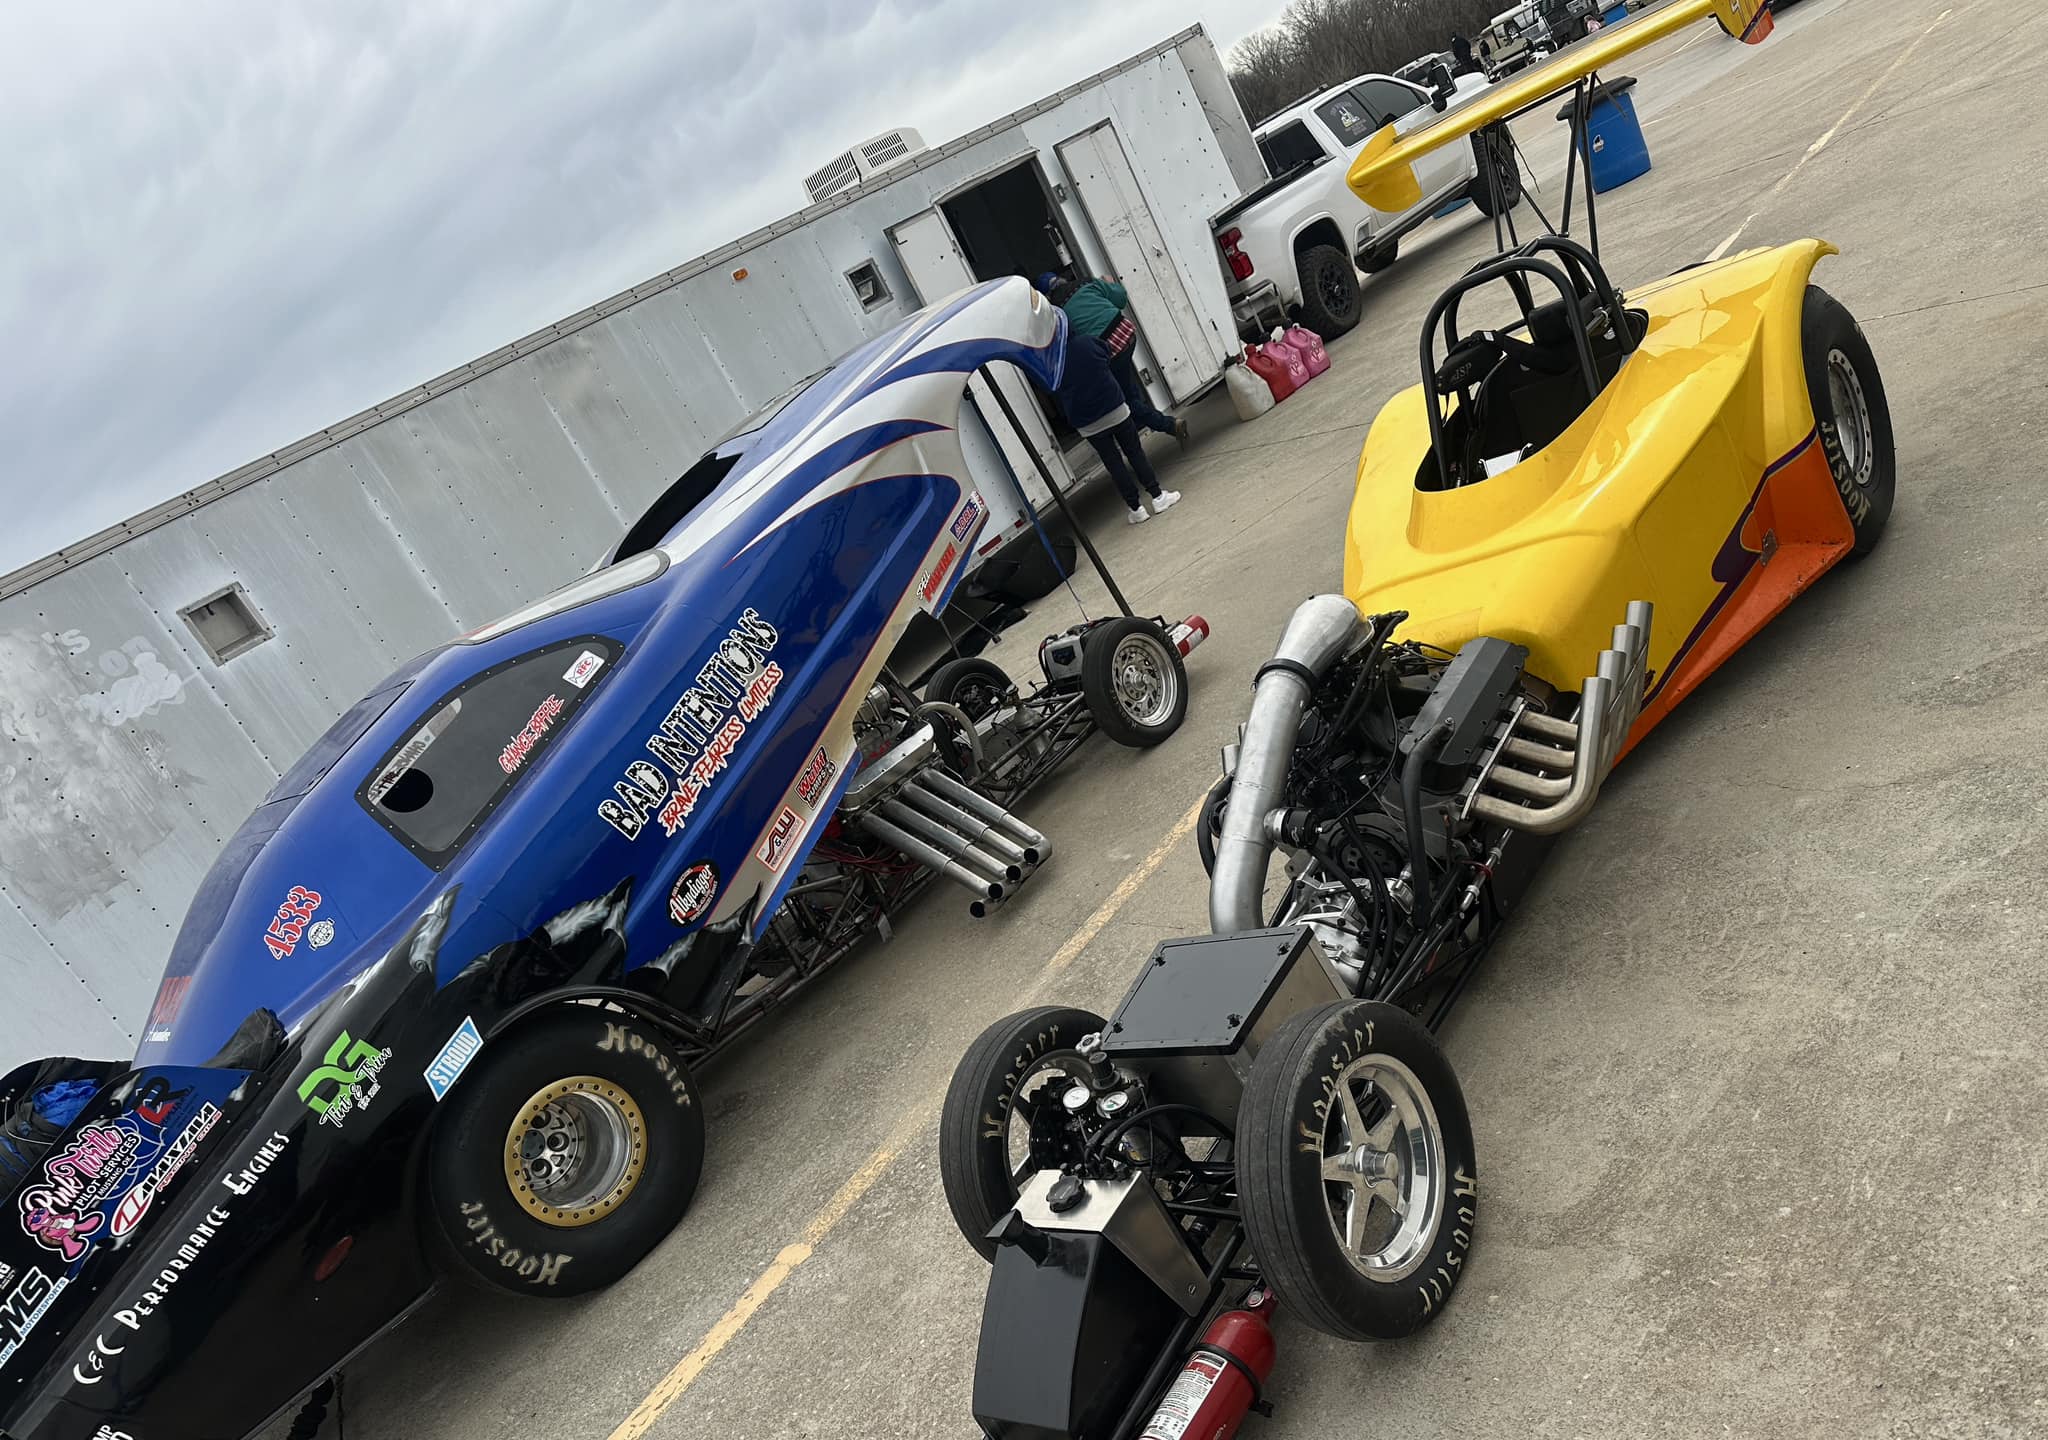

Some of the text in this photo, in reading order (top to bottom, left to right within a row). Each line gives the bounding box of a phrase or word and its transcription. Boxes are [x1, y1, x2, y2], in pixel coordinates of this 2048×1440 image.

[577, 658, 592, 675] RFC
[497, 726, 535, 774] CHANCE
[598, 607, 778, 840] BAD INTENTIONS
[657, 661, 783, 837] BRAVE FEARLESS LIMITLESS
[805, 769, 827, 801] PUMPS
[264, 885, 321, 959] 4533
[670, 864, 712, 924] Alkydigger
[319, 1093, 353, 1128] Tint
[355, 1047, 393, 1083] Trim
[429, 1031, 478, 1086] STROUD
[596, 1022, 691, 1106] Hoosier
[25, 1128, 123, 1215] Pink Turtle
[78, 1136, 137, 1206] PILOT SERVICES
[98, 1155, 132, 1195] MUSTANG OK
[113, 1207, 230, 1331] PERFORMANCE
[221, 1130, 290, 1197] ENGINES
[459, 1200, 573, 1286] Hoosier
[20, 1278, 67, 1337] MOTORSPORTS
